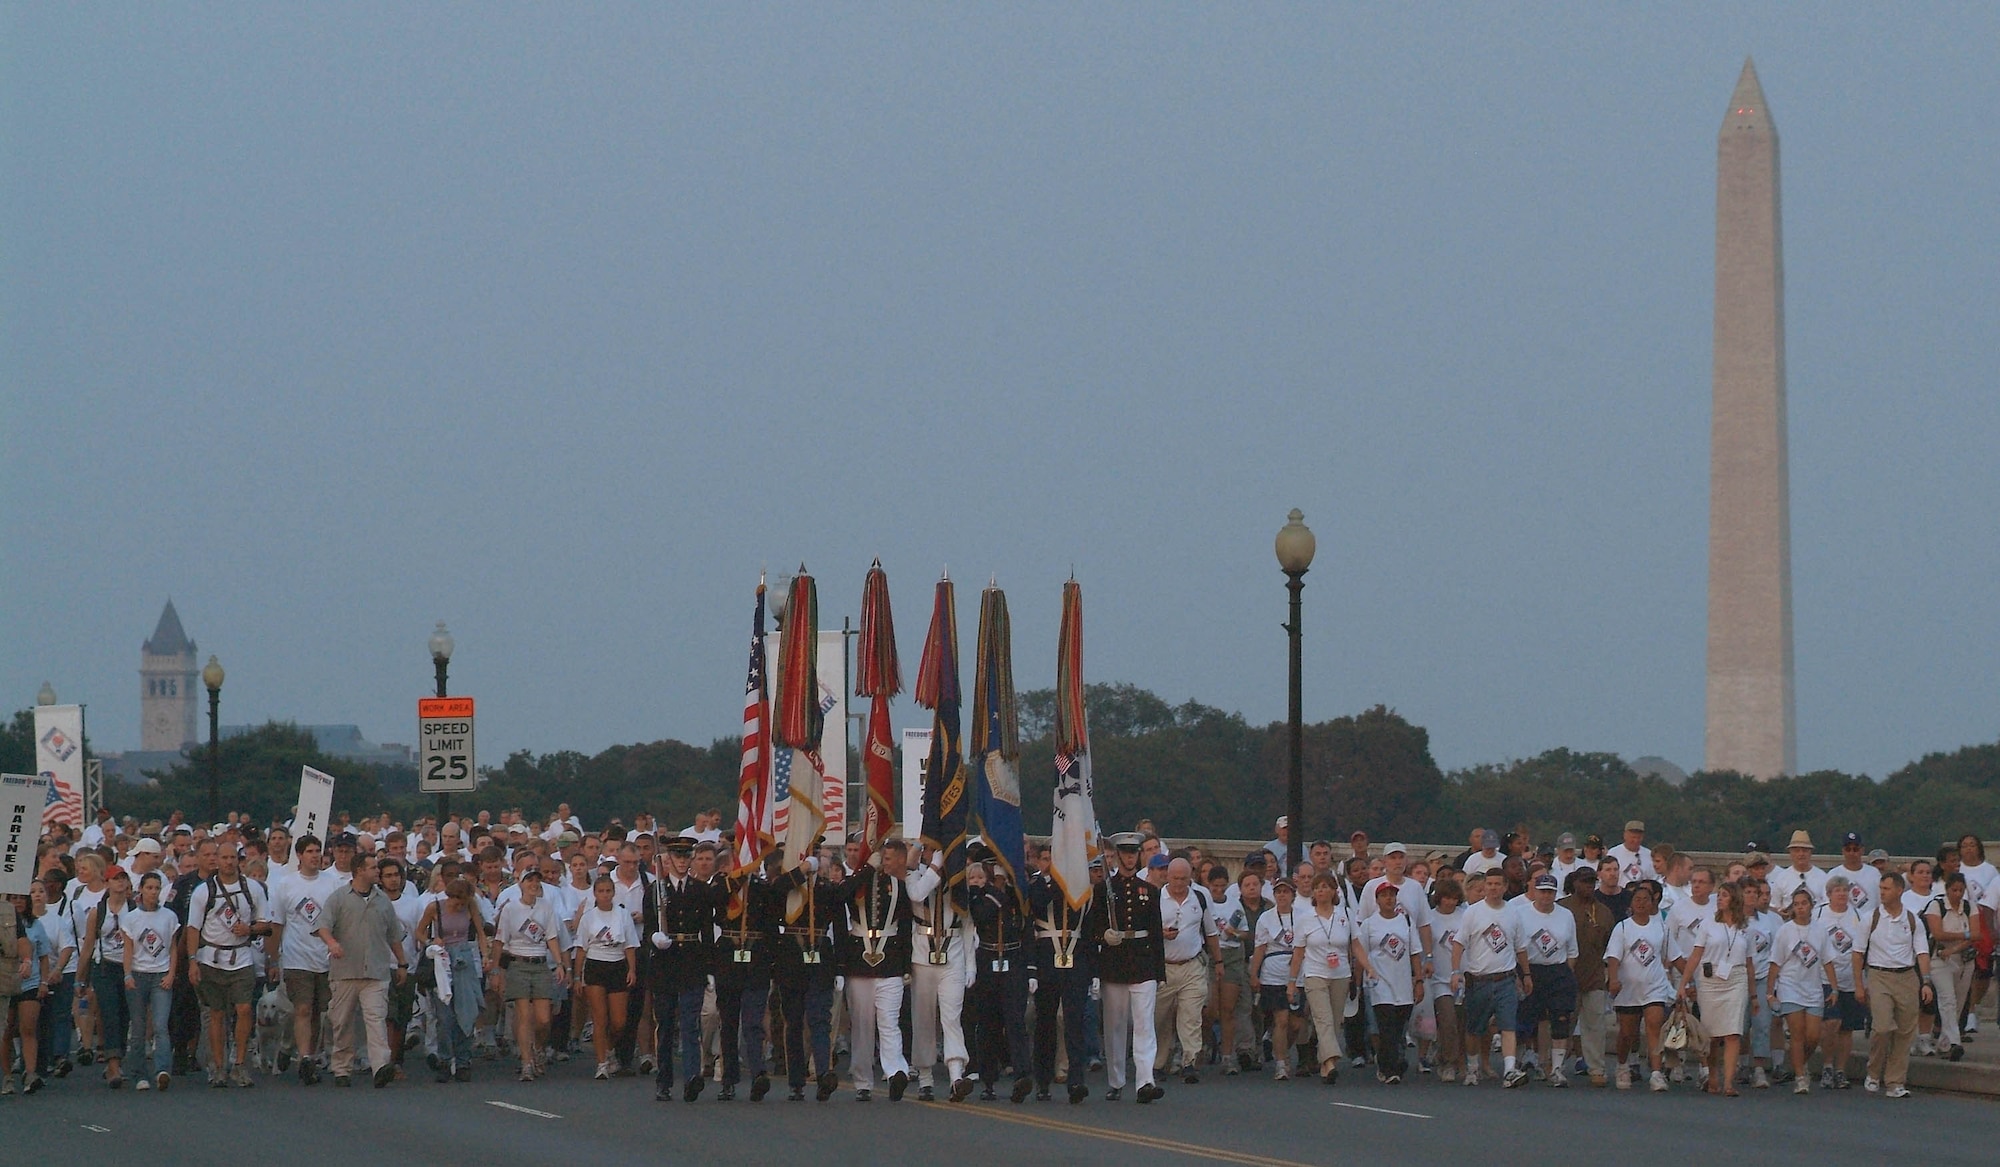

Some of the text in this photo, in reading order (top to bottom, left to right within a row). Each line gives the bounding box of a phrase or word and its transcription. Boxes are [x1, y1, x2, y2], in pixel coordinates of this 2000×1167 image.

[449, 704, 470, 712] AREA
[424, 723, 470, 735] SPEED
[429, 739, 465, 751] LIMIT
[427, 755, 468, 780] 25
[4, 805, 26, 873] MARINES
